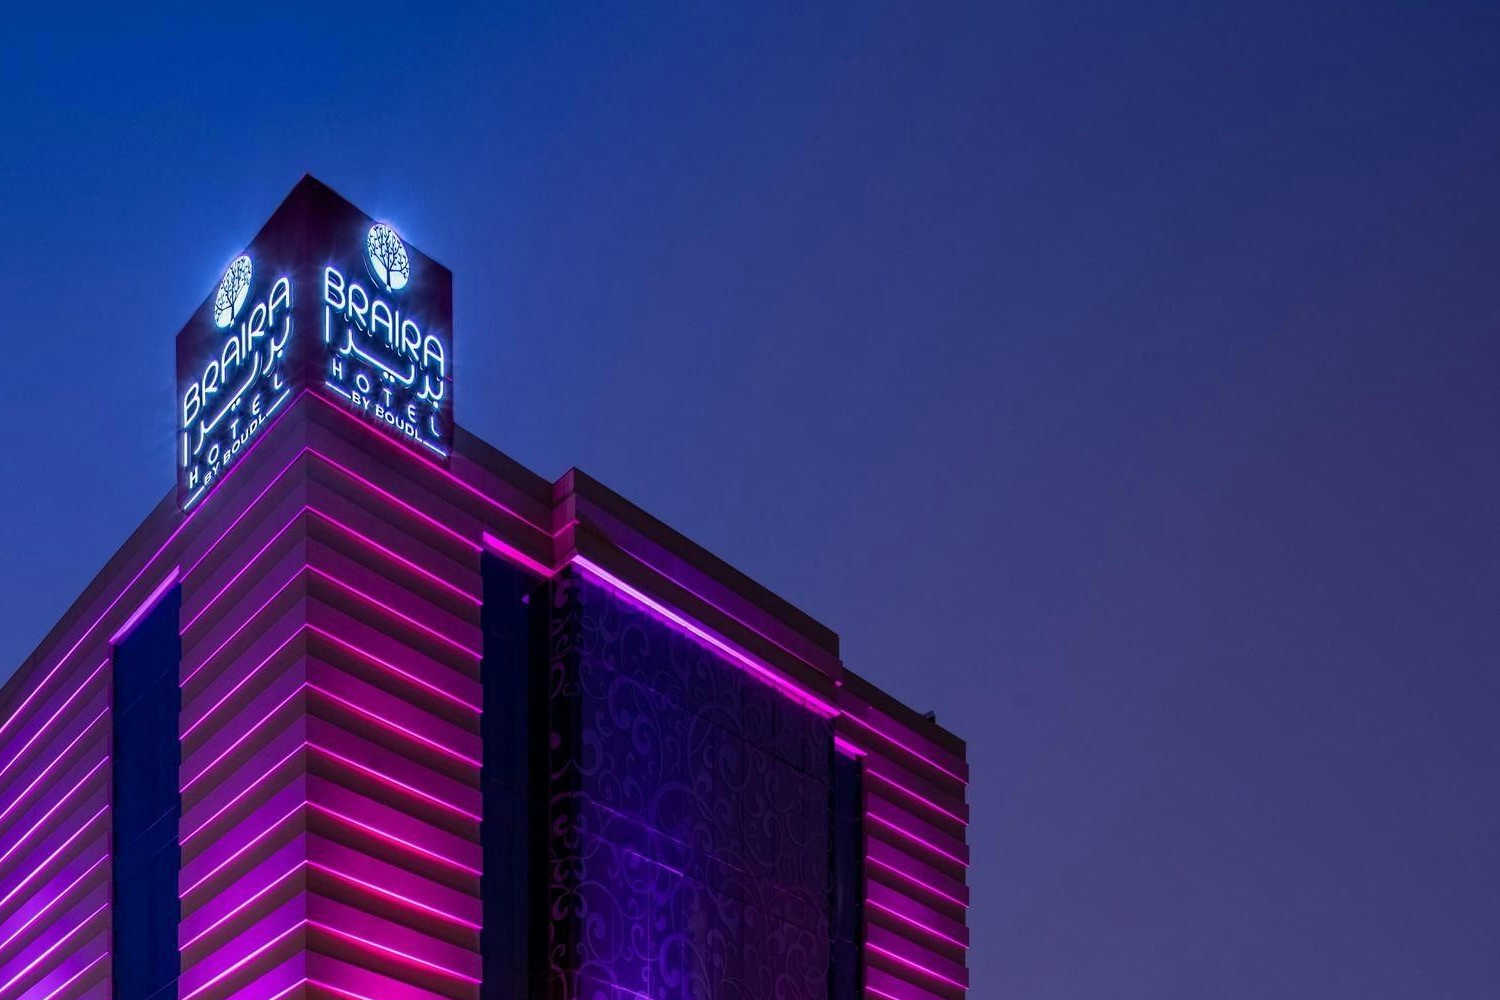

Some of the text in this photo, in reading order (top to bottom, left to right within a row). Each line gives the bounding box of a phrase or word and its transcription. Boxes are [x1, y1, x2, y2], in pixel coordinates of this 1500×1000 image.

[184, 277, 290, 426] BRAIRA
[325, 266, 445, 377] BRAIRA
[188, 374, 283, 489] HOTEL
[332, 359, 441, 437] HOTEL
[351, 391, 423, 443] BY BOUDL
[204, 414, 266, 485] BY BOUDL
